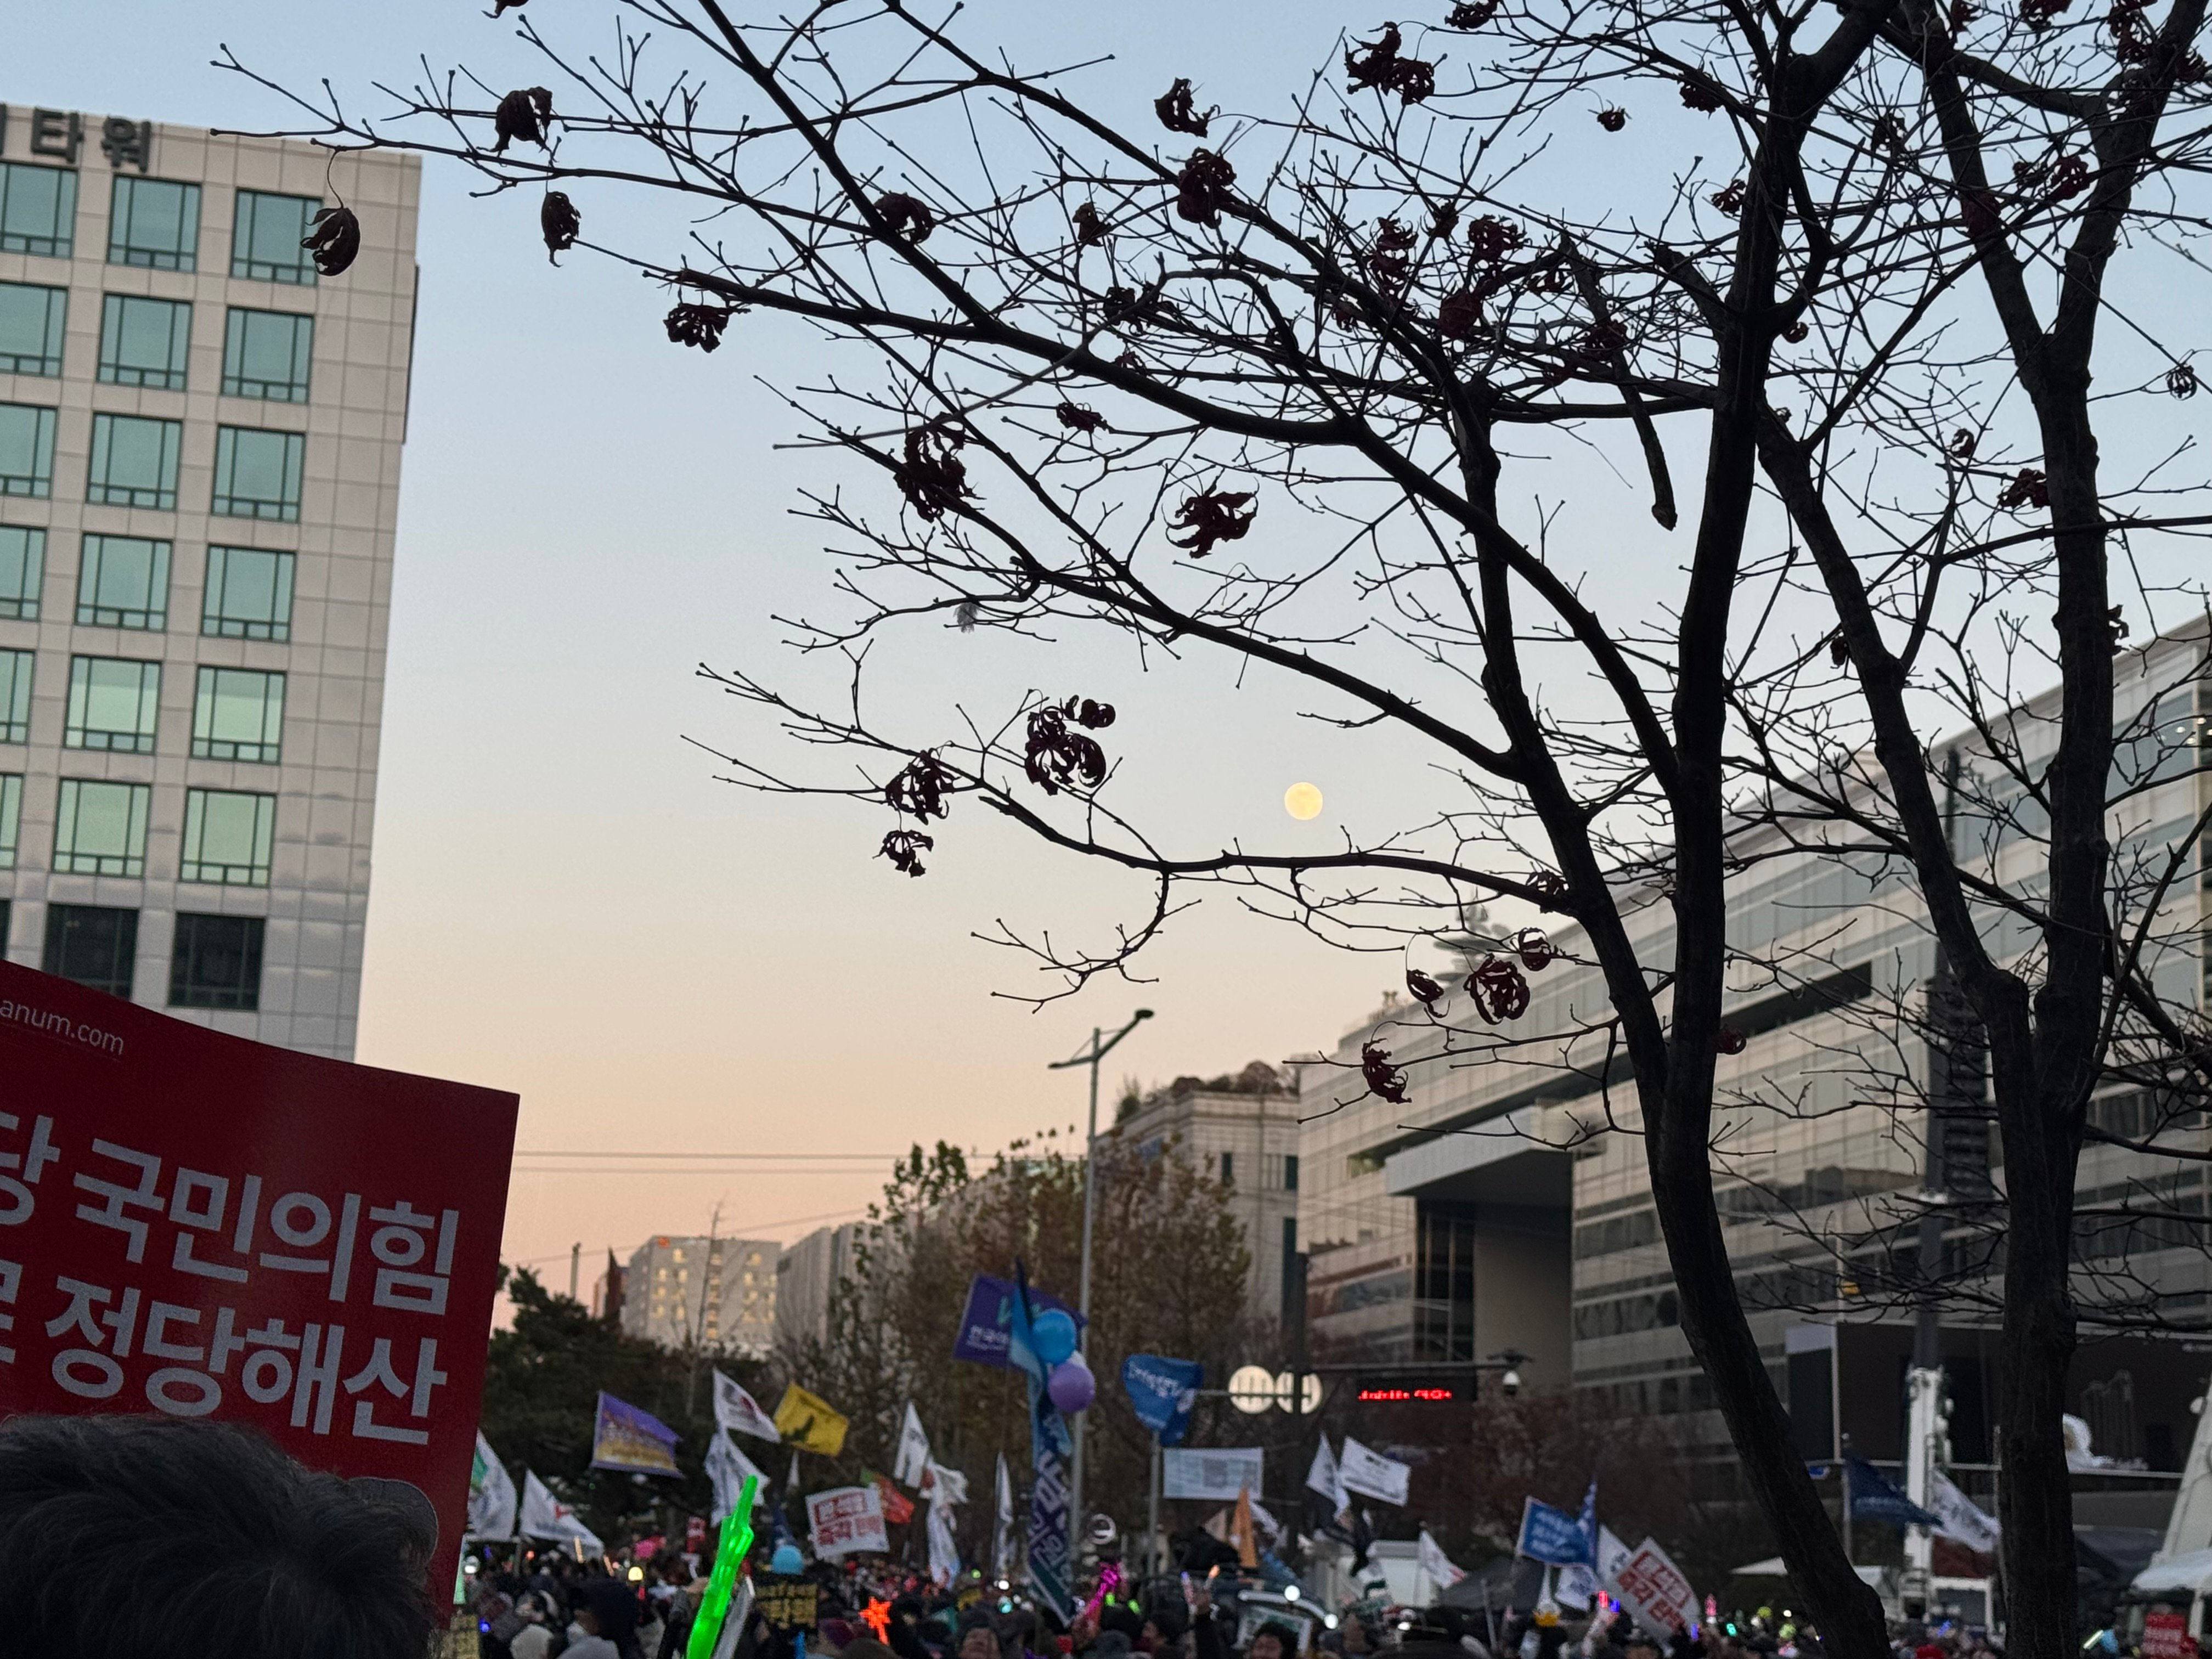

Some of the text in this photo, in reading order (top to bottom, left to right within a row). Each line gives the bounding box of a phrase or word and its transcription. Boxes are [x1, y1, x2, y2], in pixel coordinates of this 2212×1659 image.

[0, 103, 151, 173] 타워
[0, 1000, 124, 1056] anum.com
[72, 1138, 460, 1316] 국민의힘
[44, 1274, 448, 1445] 정당해산
